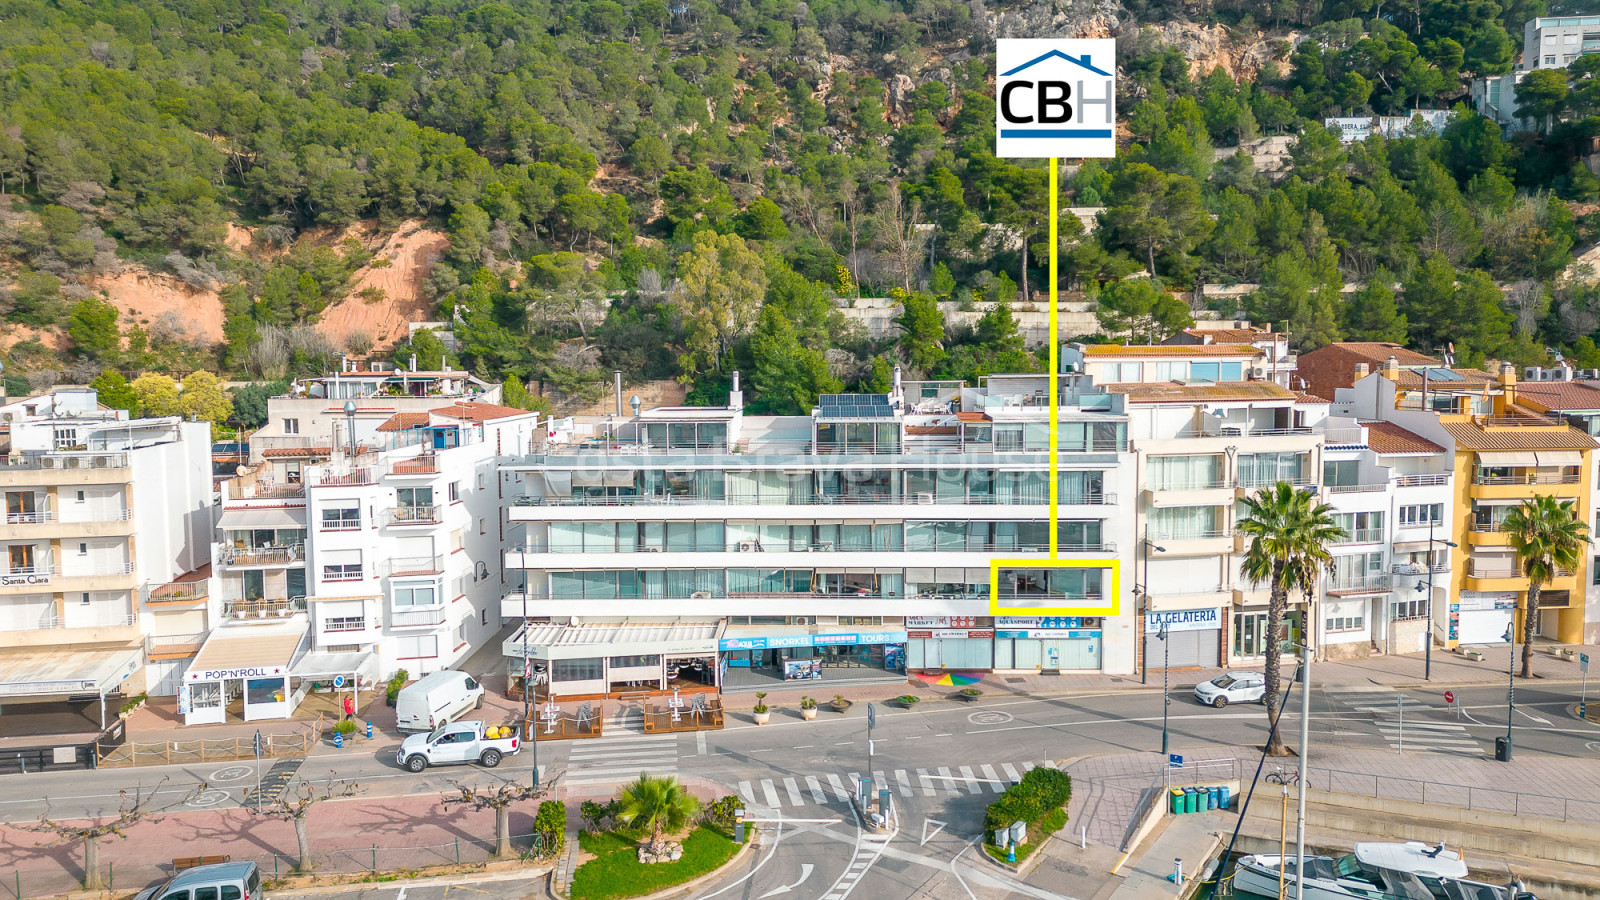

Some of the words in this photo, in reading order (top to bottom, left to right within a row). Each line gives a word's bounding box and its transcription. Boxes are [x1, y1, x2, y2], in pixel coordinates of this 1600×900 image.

[2, 576, 26, 585] Santa
[27, 575, 49, 584] Clara
[1150, 613, 1162, 625] LA
[1165, 610, 1217, 624] GELATERIA
[769, 637, 809, 647] SNORKEL
[861, 634, 890, 643] TOURS
